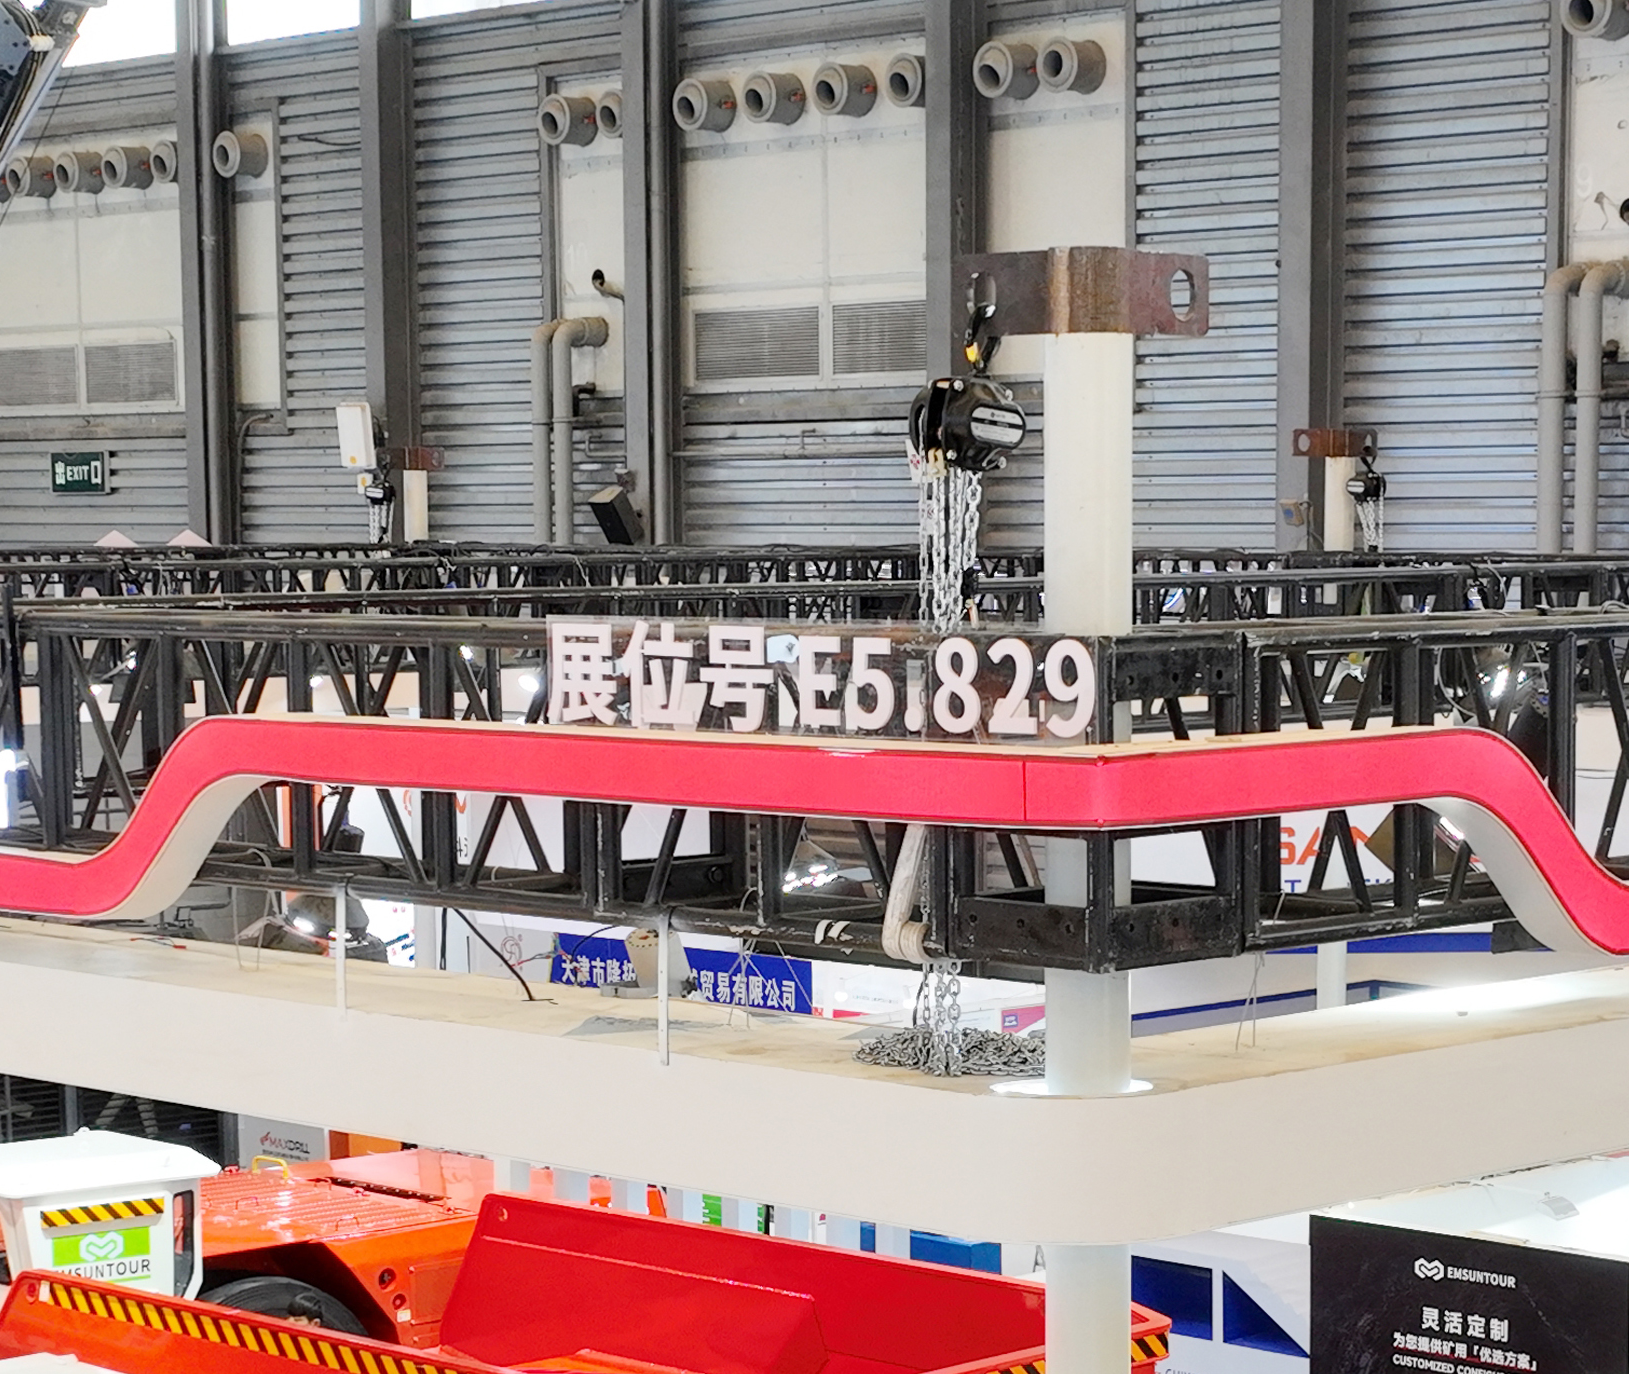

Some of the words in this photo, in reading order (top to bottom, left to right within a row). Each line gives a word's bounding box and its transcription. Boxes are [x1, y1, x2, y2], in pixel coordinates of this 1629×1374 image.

[66, 465, 90, 481] EXIT
[1446, 1265, 1517, 1289] EMSUNTOUR
[1421, 1305, 1510, 1343] 灵活定制
[1392, 1353, 1455, 1374] CUSTOMIZED
